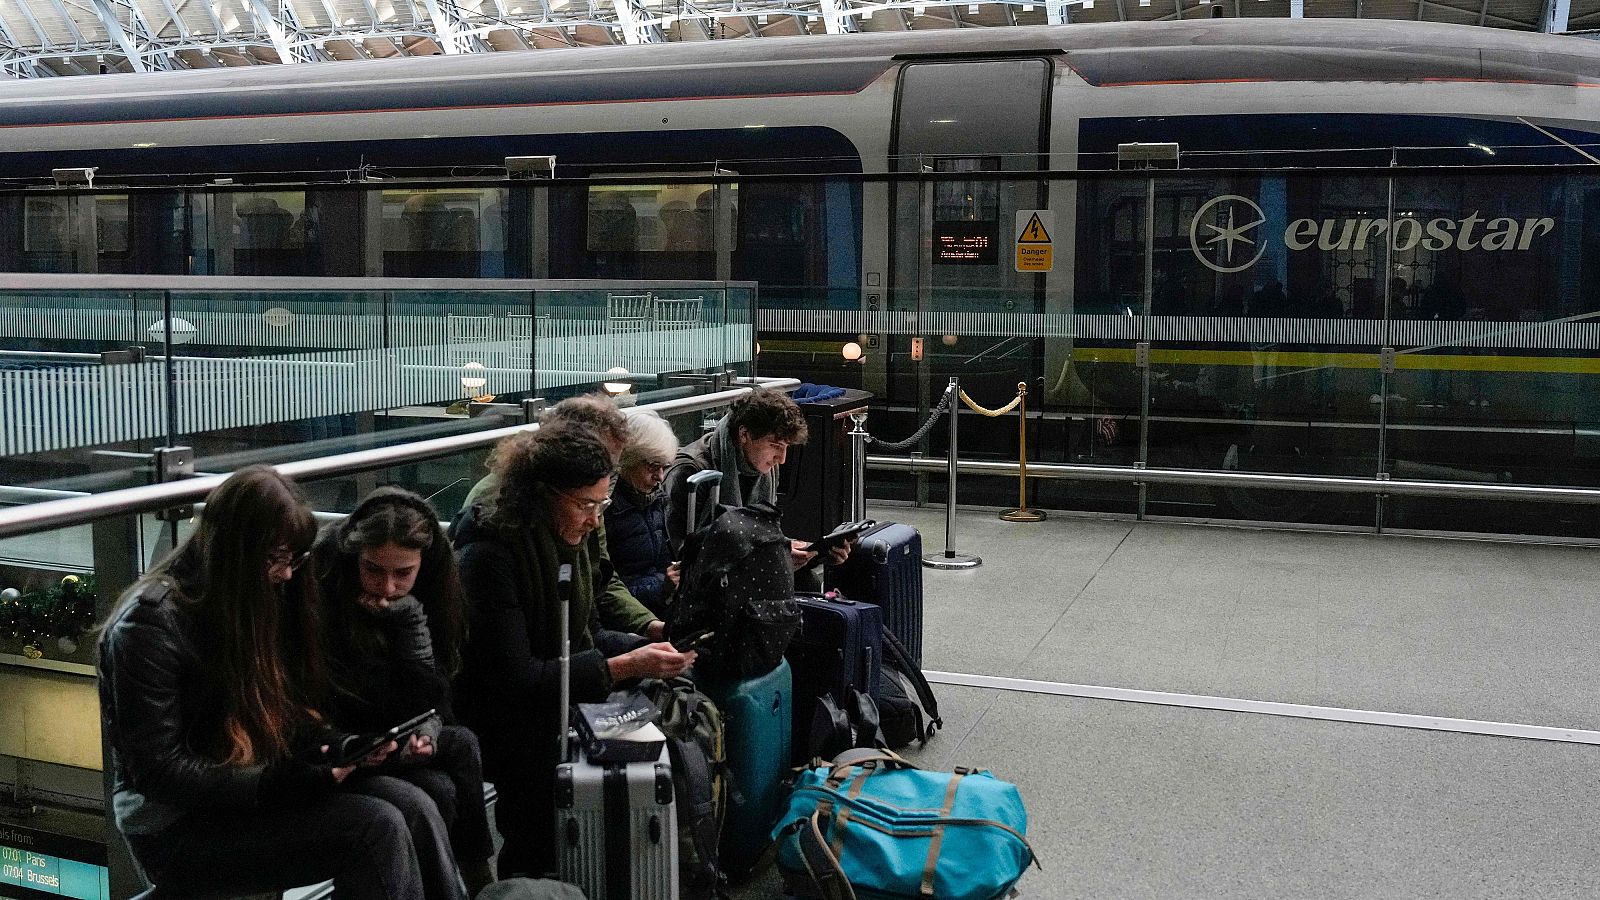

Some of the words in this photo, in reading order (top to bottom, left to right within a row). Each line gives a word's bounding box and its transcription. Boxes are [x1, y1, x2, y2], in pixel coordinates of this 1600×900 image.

[1284, 209, 1554, 251] eurostar
[1021, 248, 1047, 256] Danger
[26, 852, 46, 867] Paris
[27, 869, 59, 887] Brussels
